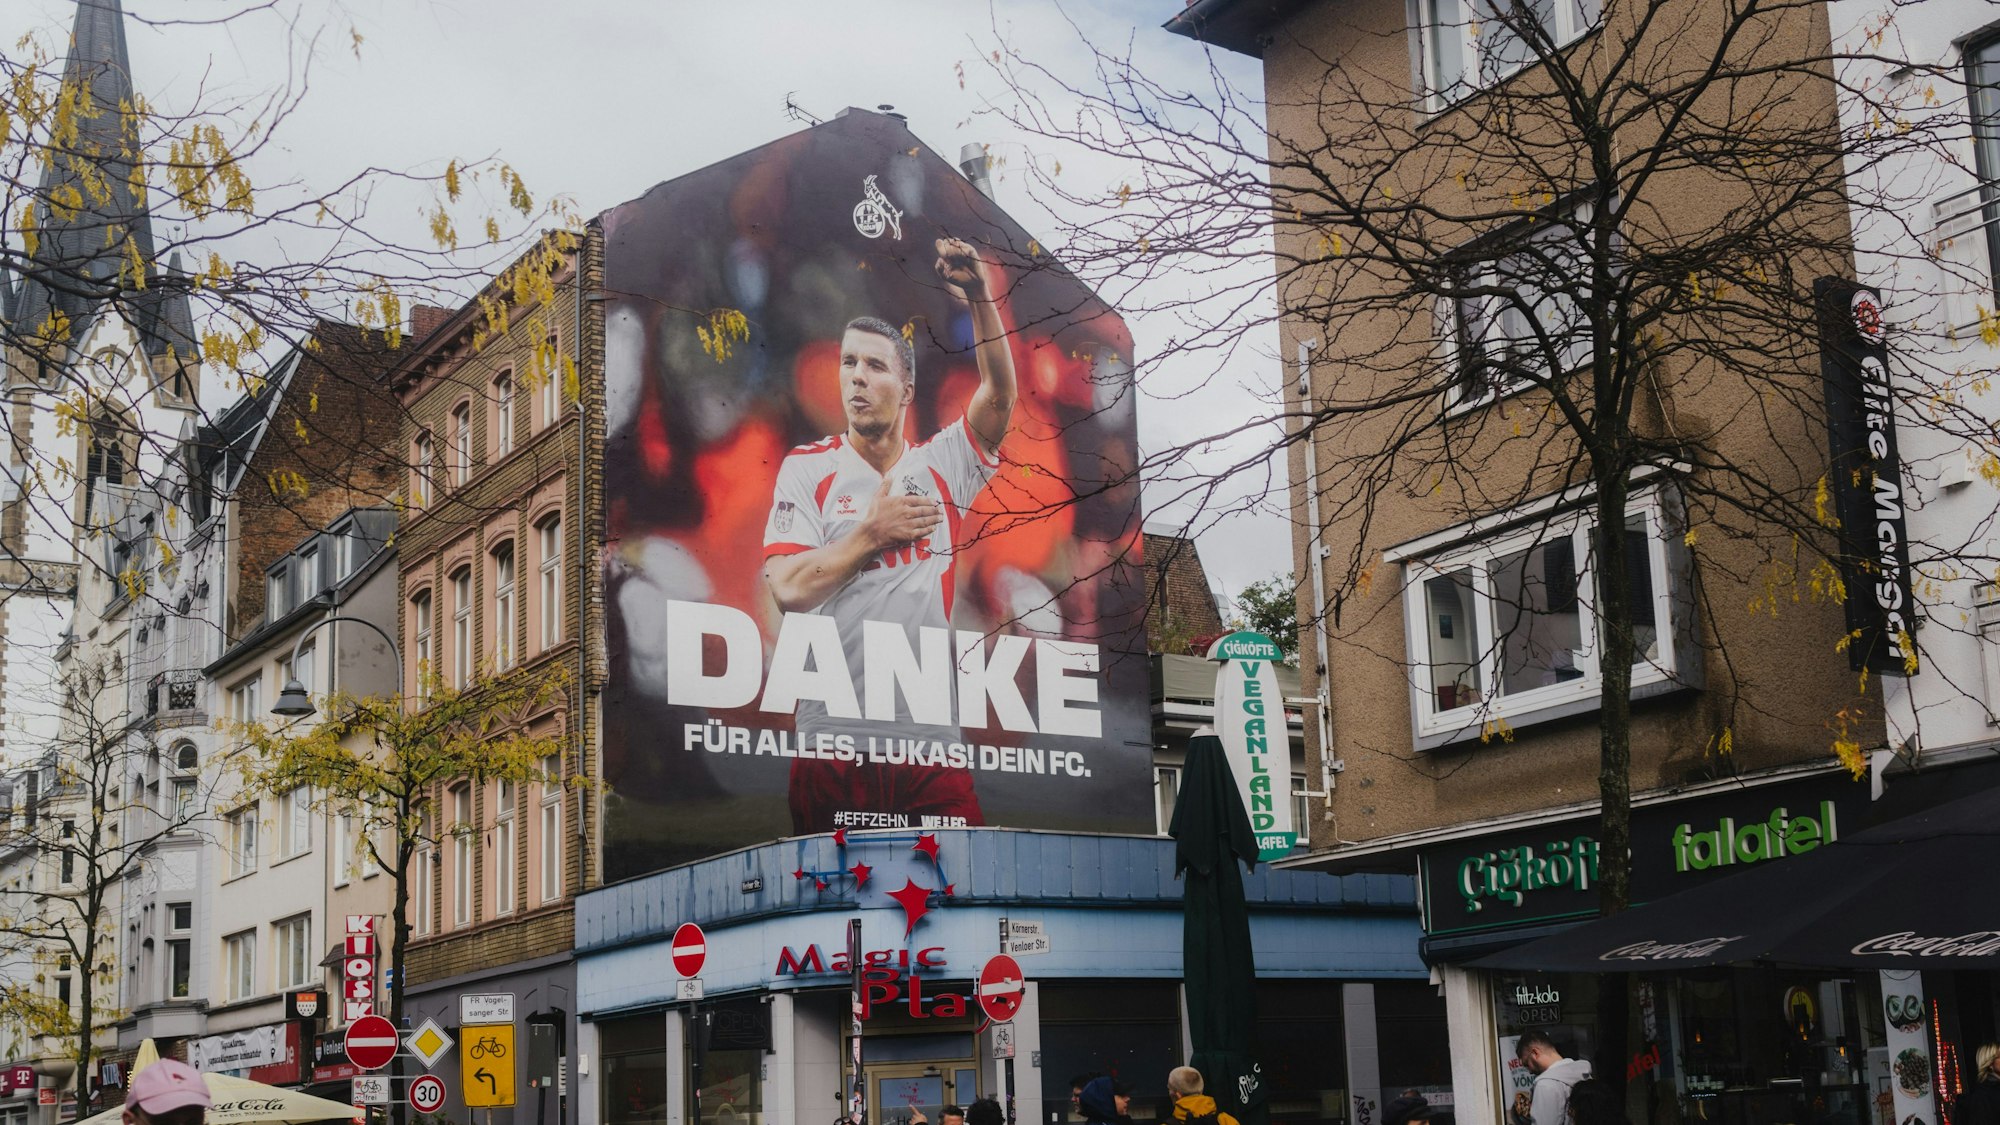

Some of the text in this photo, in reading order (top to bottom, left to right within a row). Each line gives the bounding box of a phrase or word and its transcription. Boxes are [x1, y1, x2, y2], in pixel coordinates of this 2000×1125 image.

[1861, 356, 1890, 460] Elite
[666, 599, 1102, 738] DANKE
[684, 719, 1092, 777] FÜR ALLES, LUKAS! DEIN FC.
[1240, 661, 1276, 831] VEGANLAND
[834, 811, 909, 828] #EFFZEHN
[1256, 836, 1290, 850] LAFEL
[1673, 800, 1838, 872] falafel
[1458, 834, 1631, 913] Çiğköft
[1012, 923, 1040, 935] Körnerstr.
[1010, 939, 1048, 952] Venloer Str.
[346, 916, 373, 1020] KIOSK
[776, 944, 948, 984] Magic
[470, 996, 481, 1004] FR
[1516, 984, 1560, 1005] fritz-kola
[469, 1009, 494, 1018] sanger
[1520, 1007, 1559, 1023] OPEN
[322, 1040, 344, 1056] Venloer
[17, 1070, 30, 1085] T
[417, 1085, 438, 1102] 30
[205, 1098, 286, 1113] ca-Cola
